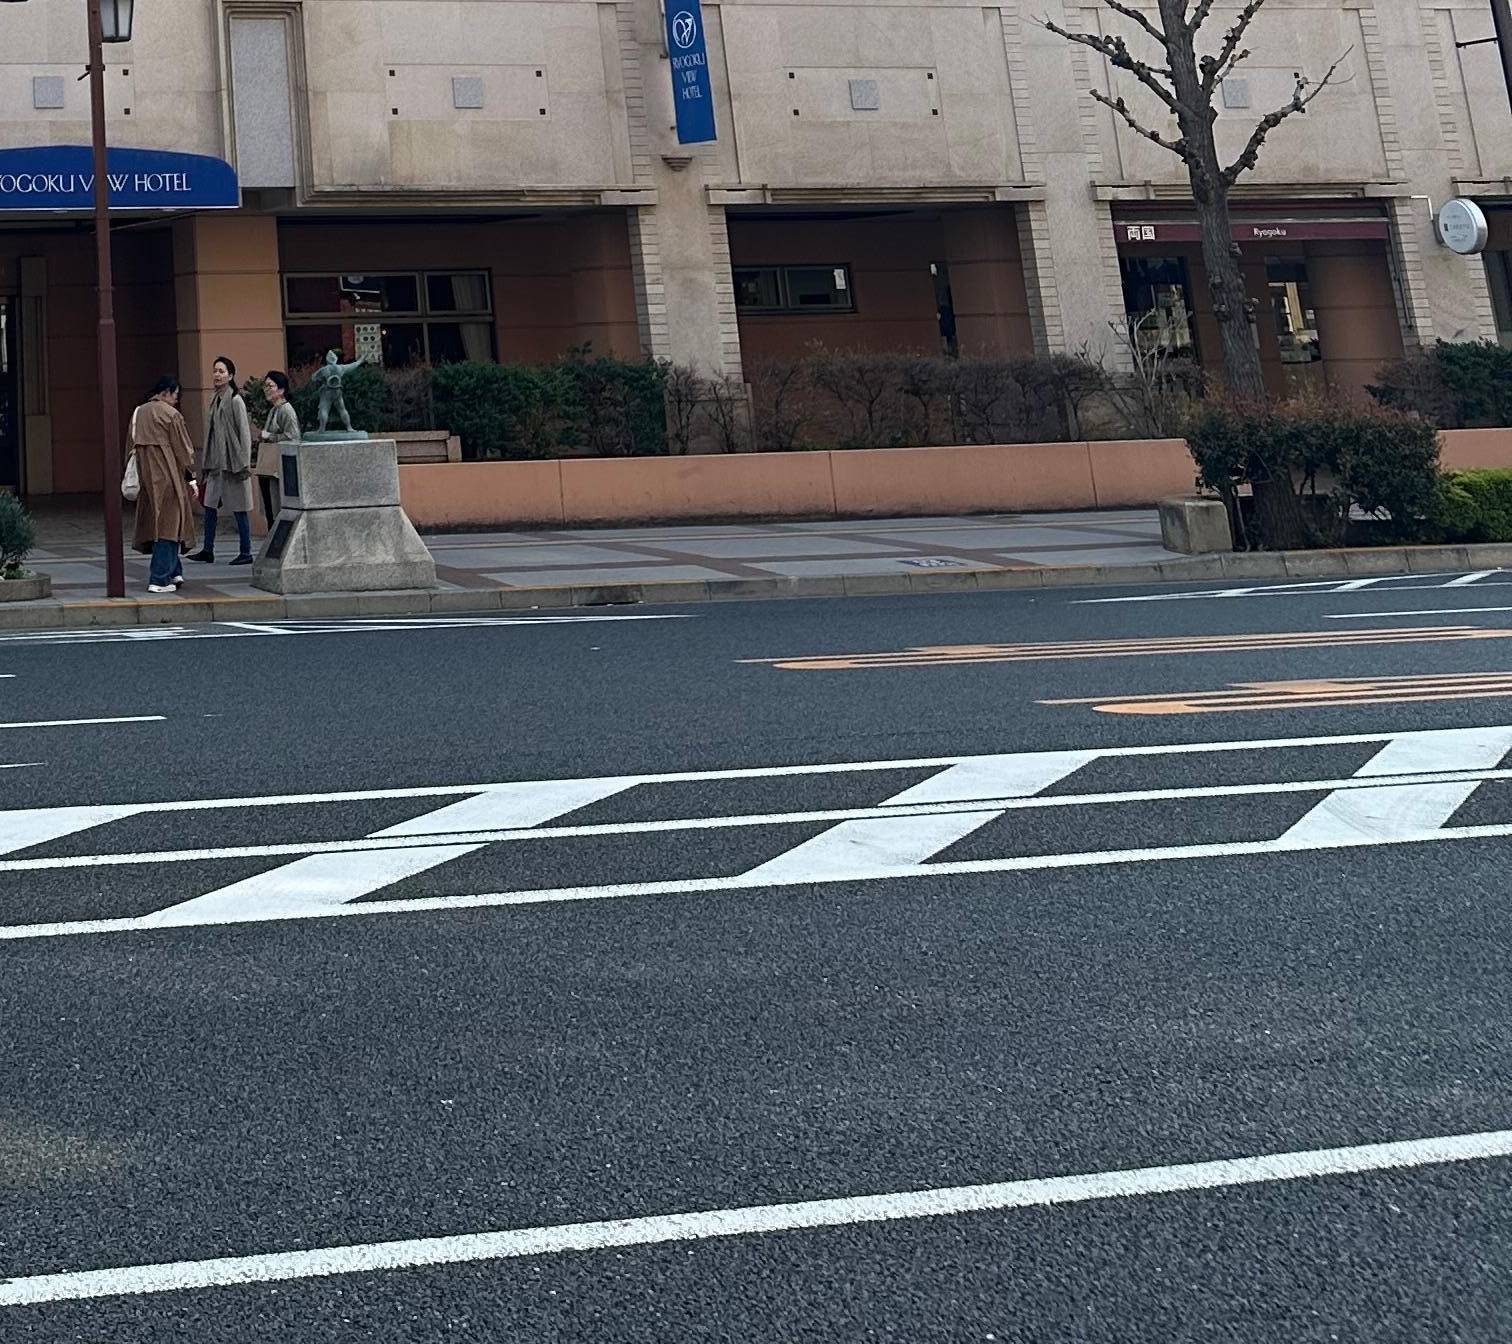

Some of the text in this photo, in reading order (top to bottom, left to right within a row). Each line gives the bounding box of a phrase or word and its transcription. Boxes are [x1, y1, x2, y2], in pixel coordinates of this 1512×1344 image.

[79, 173, 129, 192] VW
[135, 172, 192, 192] HOTEL
[1127, 225, 1156, 241] 両国
[1253, 226, 1287, 239] Ryogoku
